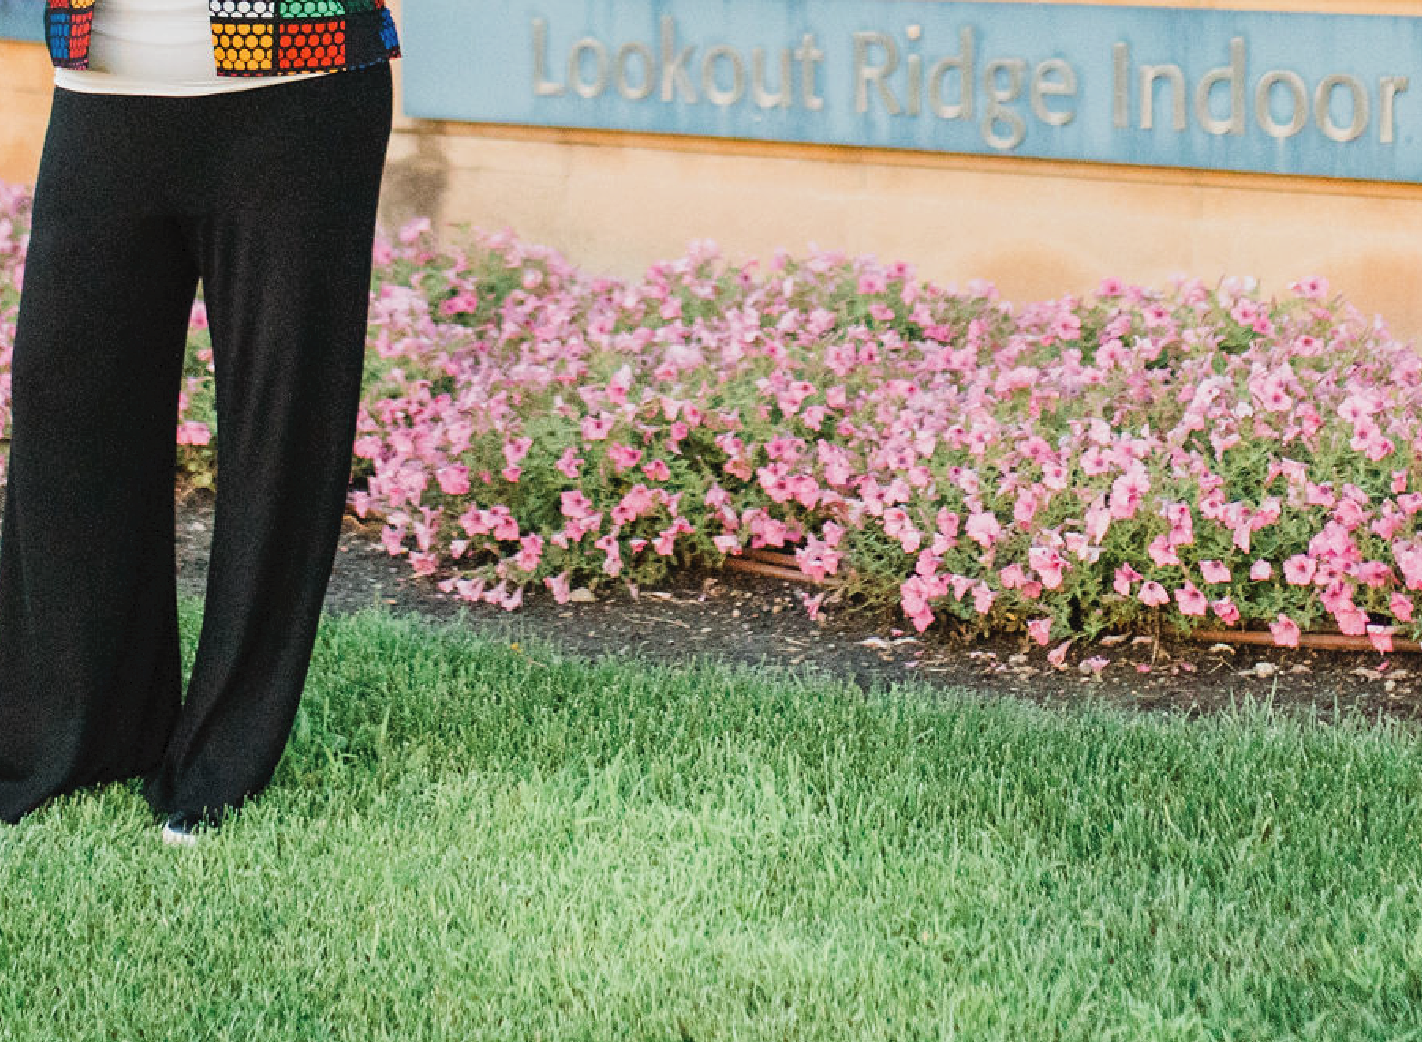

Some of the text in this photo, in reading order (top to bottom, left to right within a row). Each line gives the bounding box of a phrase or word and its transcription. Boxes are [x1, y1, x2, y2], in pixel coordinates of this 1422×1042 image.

[531, 17, 826, 110] Lookout
[852, 24, 1078, 150] Ridge
[1112, 36, 1410, 145] Indoor
